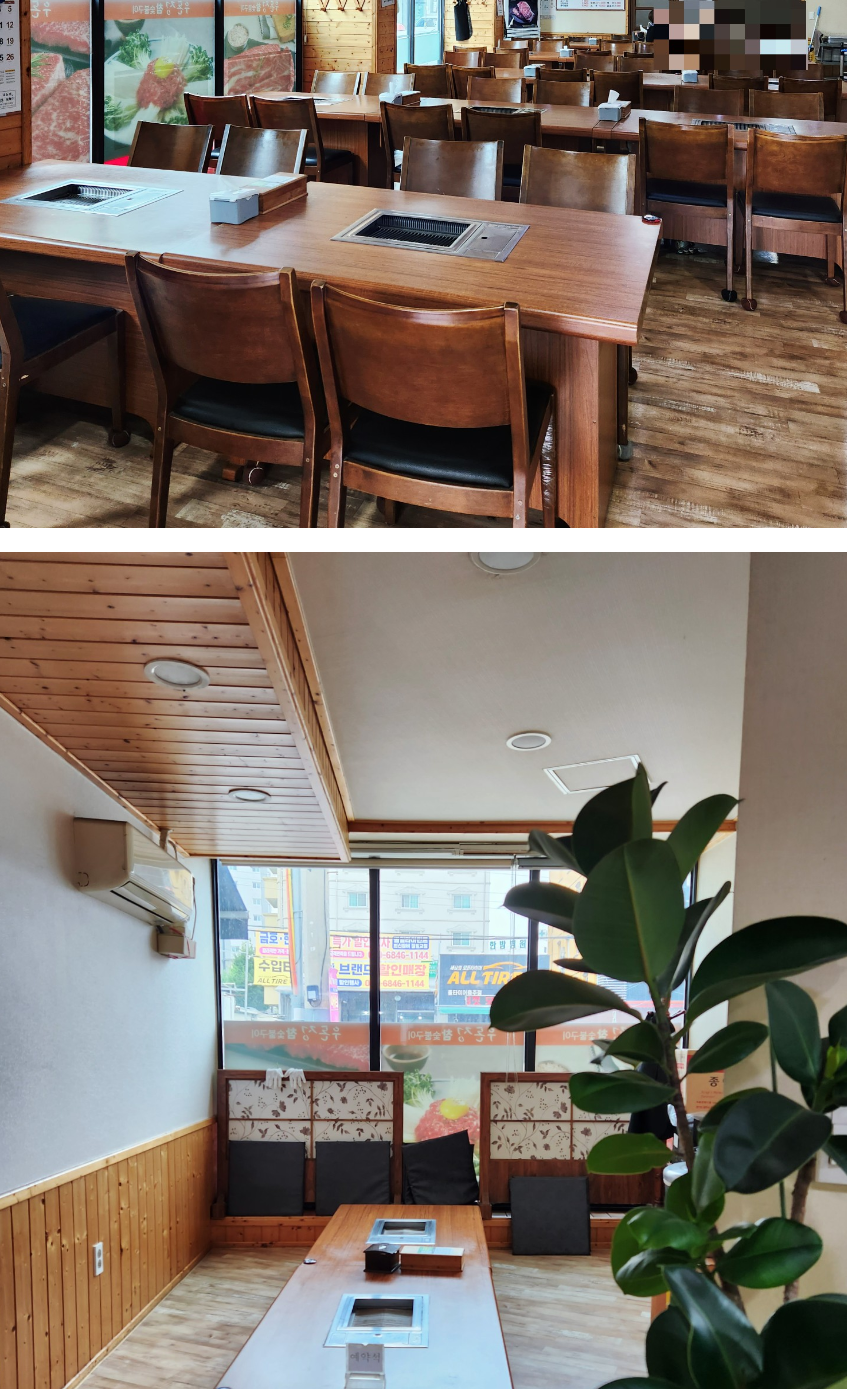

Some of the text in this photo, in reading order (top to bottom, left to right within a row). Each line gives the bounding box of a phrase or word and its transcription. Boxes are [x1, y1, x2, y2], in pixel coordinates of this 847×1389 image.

[6, 21, 14, 29] 12
[6, 37, 14, 45] 19
[6, 53, 15, 61] 26
[446, 970, 481, 985] ALL
[350, 1351, 381, 1363] 예약석
